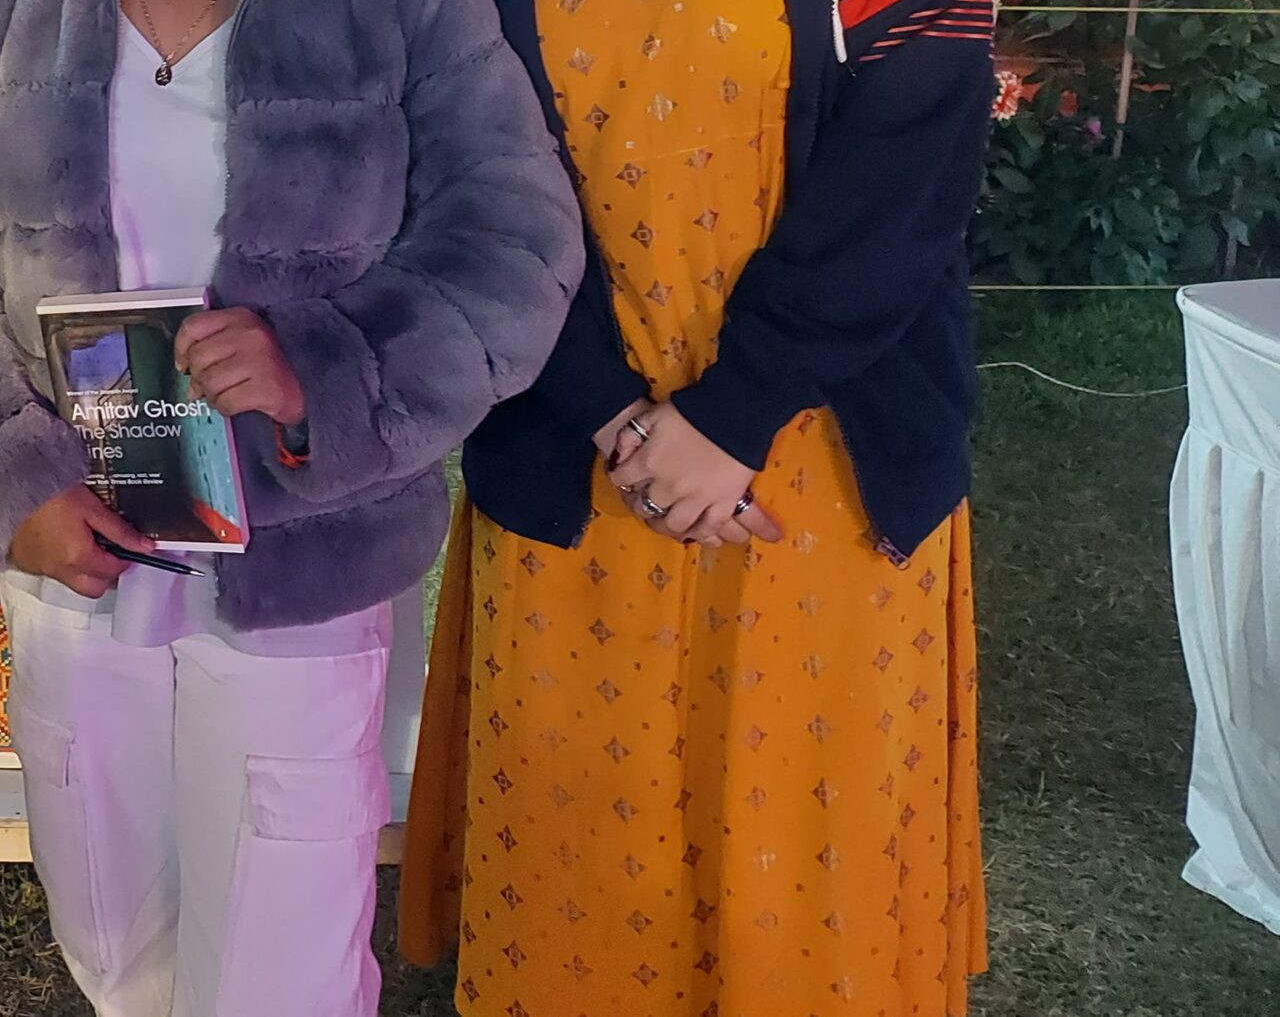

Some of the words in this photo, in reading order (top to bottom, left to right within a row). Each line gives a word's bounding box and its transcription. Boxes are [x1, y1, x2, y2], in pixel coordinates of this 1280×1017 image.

[72, 401, 140, 421] Amitav
[144, 399, 211, 418] Ghosh
[74, 424, 106, 440] The
[109, 422, 182, 439] Shadow
[86, 443, 124, 459] ines
